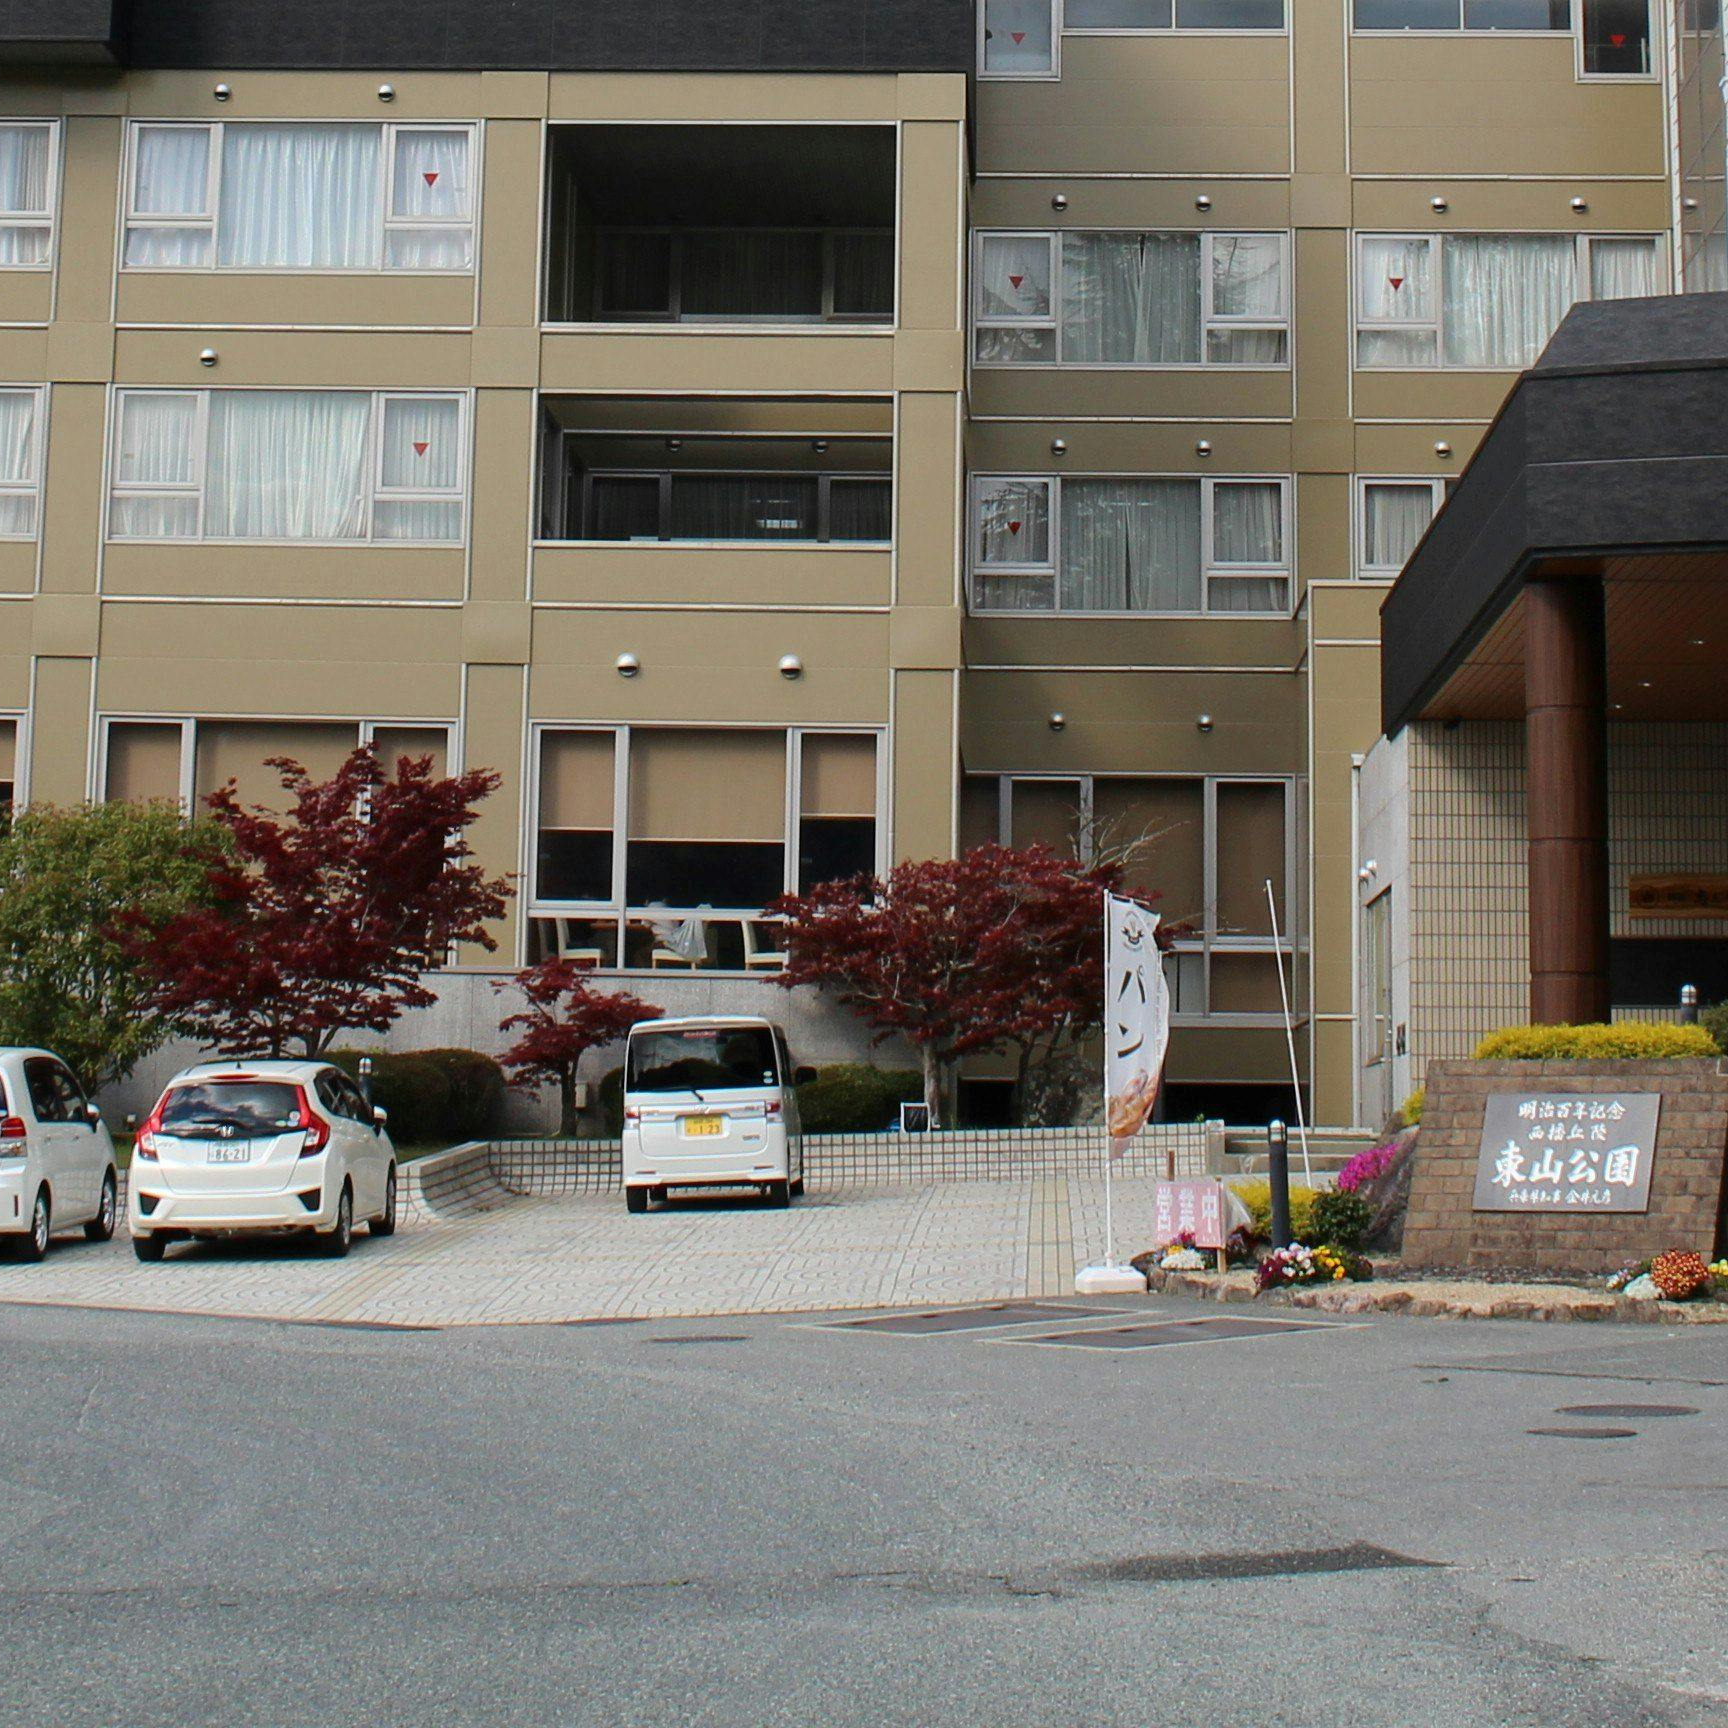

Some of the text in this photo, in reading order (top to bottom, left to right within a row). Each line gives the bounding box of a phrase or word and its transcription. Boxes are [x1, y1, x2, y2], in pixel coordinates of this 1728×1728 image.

[1117, 964, 1146, 1059] パン
[1489, 1138, 1640, 1187] 東山公園
